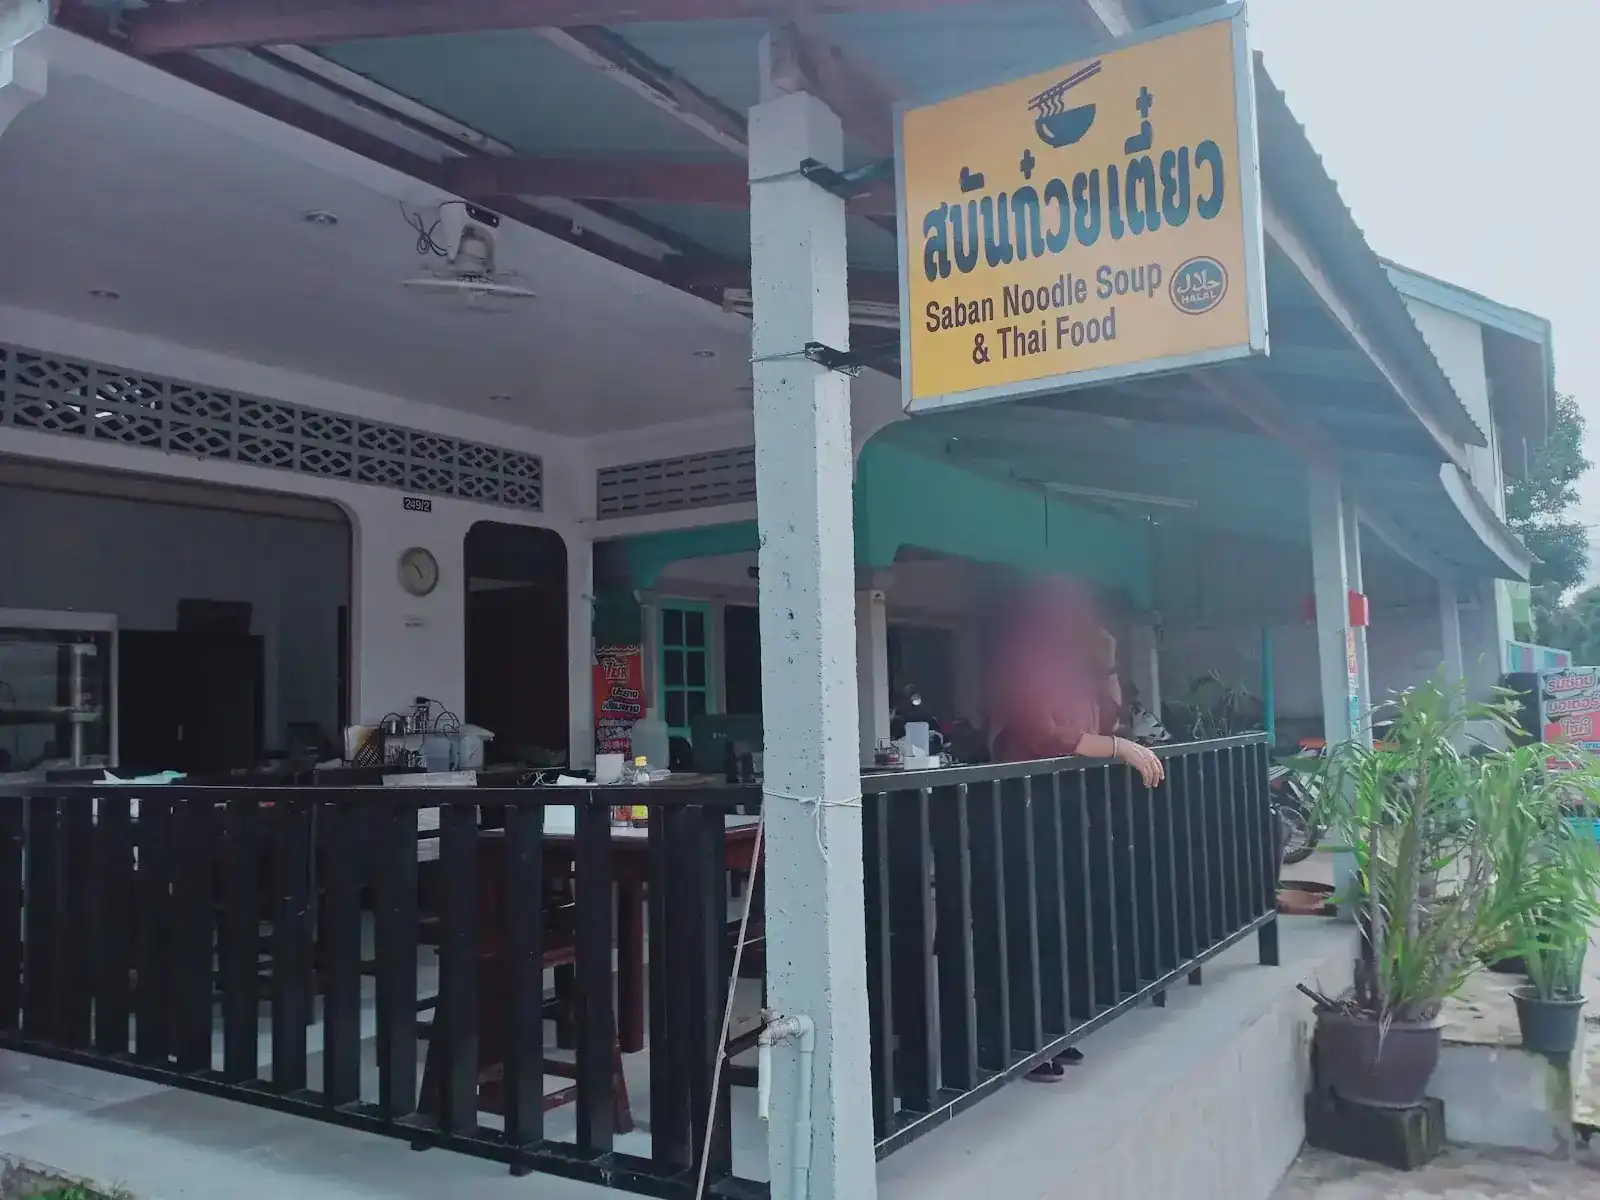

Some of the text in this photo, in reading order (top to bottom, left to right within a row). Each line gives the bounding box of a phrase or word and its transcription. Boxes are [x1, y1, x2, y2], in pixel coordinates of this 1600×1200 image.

[923, 85, 1225, 283] สบันก๋วยเตี๋ยว
[926, 262, 1163, 333] Saban Noodle Soup
[1176, 268, 1222, 294] حلال
[1181, 290, 1217, 304] HALAL
[972, 306, 1117, 365] & Thai Food
[405, 498, 431, 512] 249/2
